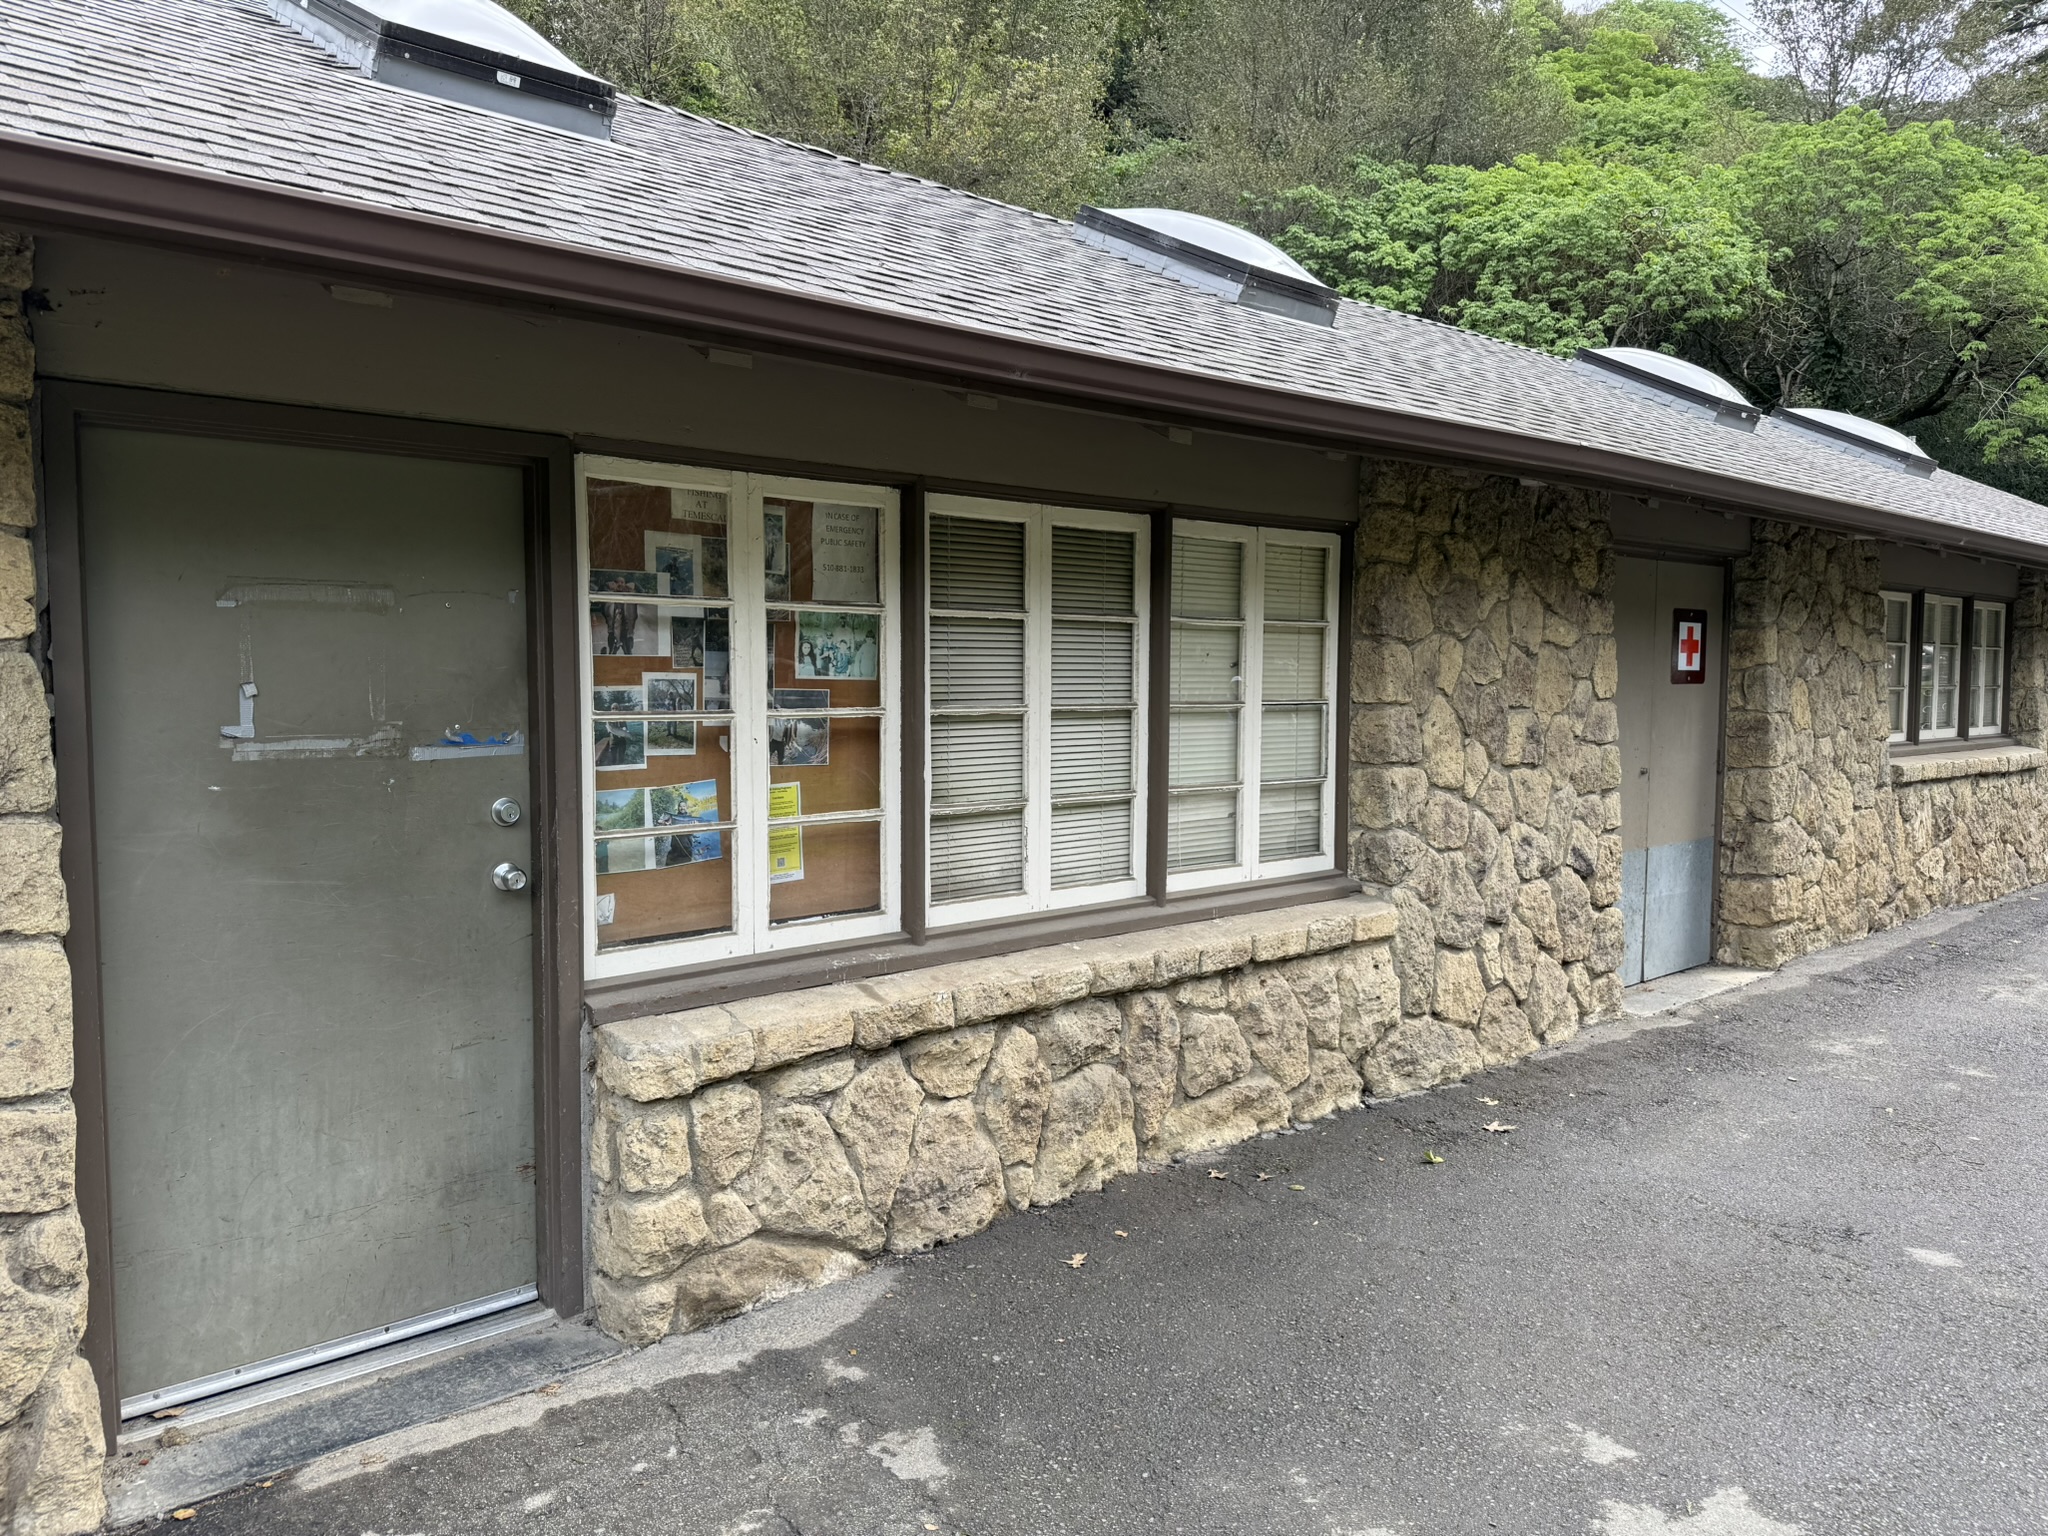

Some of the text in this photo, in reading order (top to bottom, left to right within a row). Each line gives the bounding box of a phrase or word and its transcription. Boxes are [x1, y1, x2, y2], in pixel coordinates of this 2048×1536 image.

[687, 489, 722, 499] FISHING
[695, 500, 708, 509] AT
[825, 512, 860, 522] IN CASE OF
[825, 525, 865, 535] EMERGENCY
[820, 537, 866, 548] PUBLIC SAFETY
